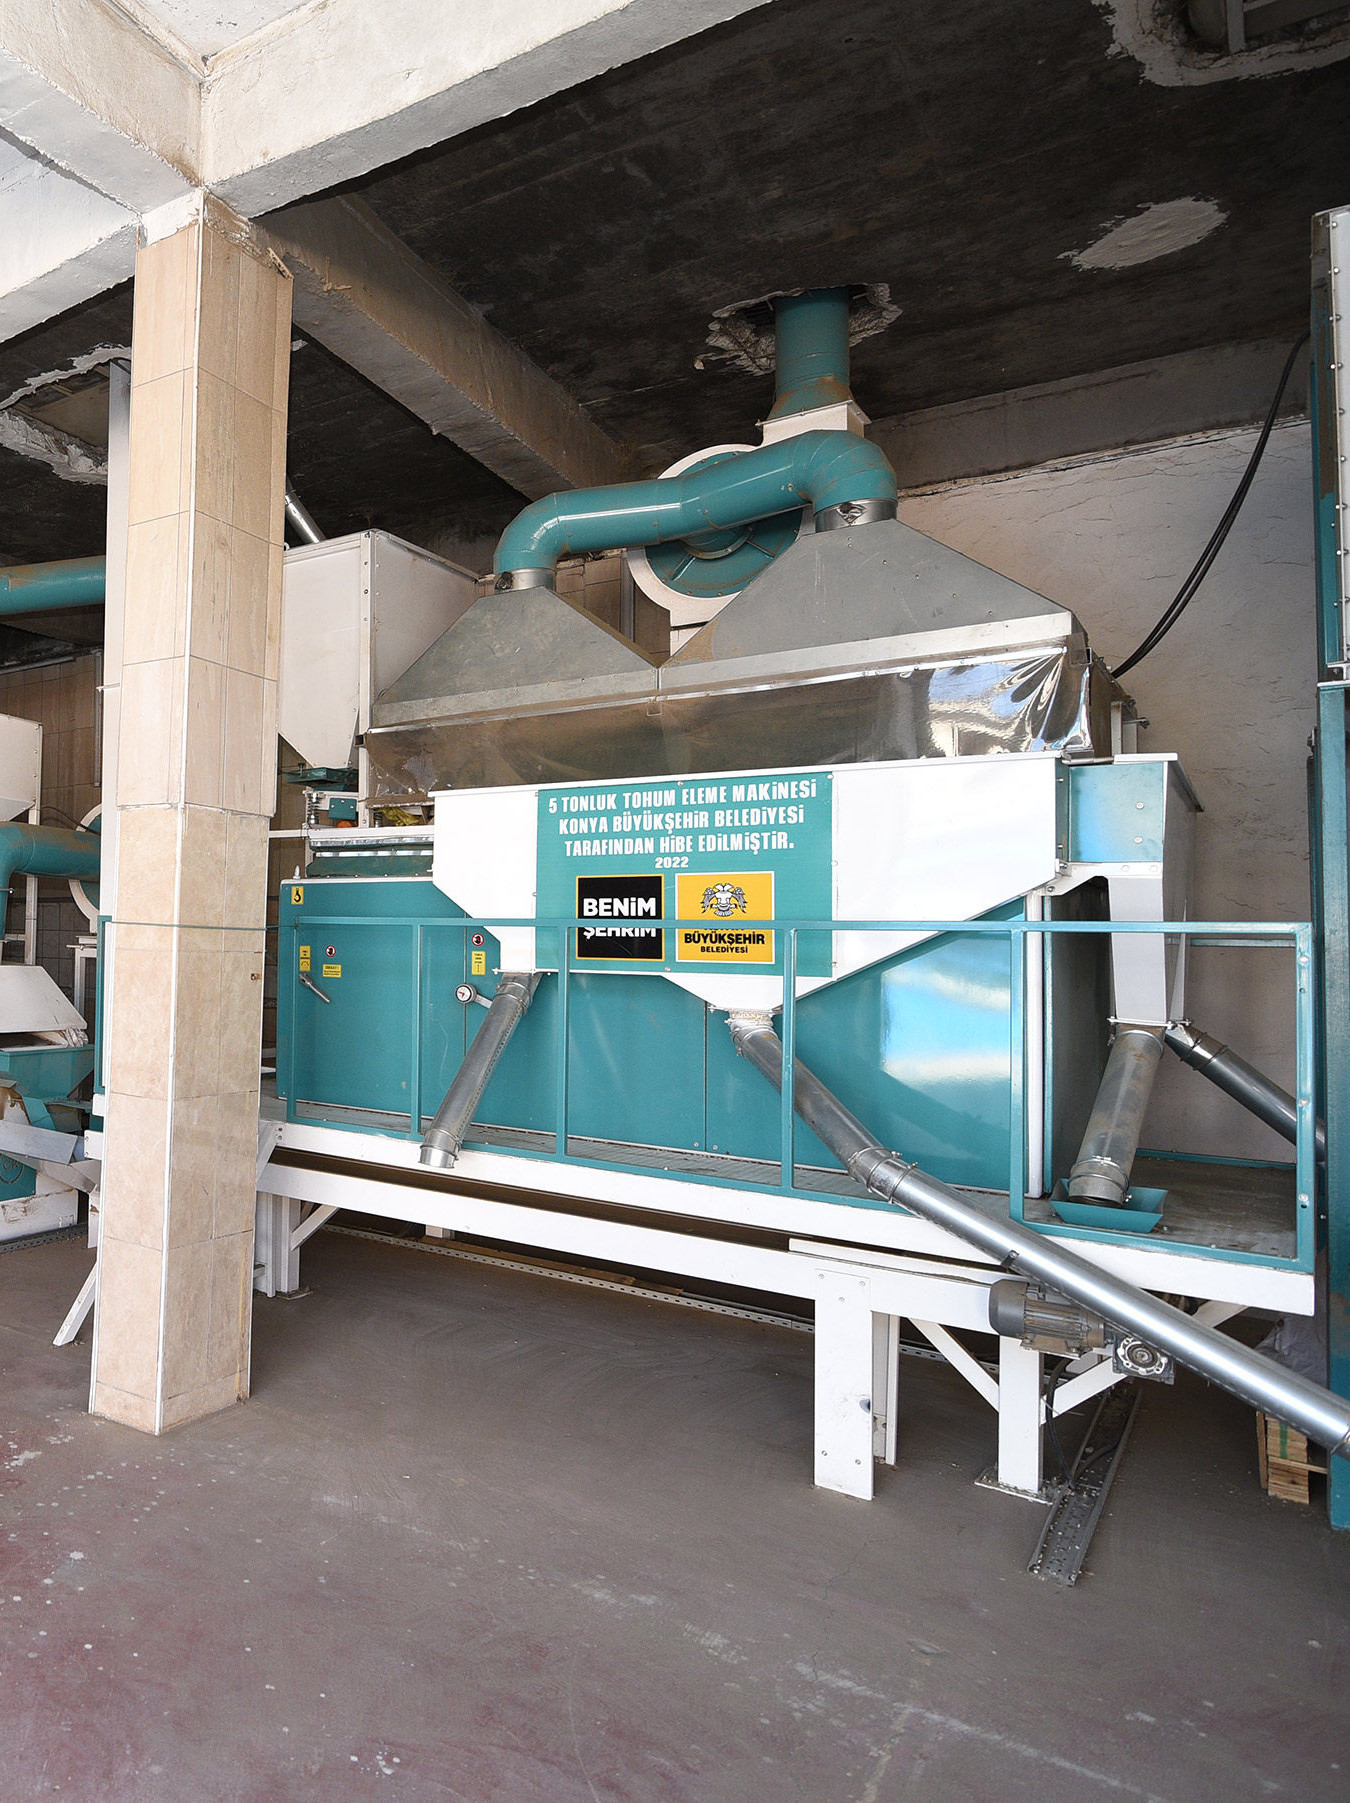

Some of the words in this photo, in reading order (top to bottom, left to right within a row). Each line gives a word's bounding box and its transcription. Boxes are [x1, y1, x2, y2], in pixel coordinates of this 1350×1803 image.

[548, 797, 558, 814] 5
[561, 793, 618, 813] TONLUK
[622, 789, 676, 810] TOHUM
[681, 785, 727, 806] ELEME
[558, 816, 608, 835] KONYA
[564, 837, 655, 857] TARAFINDAN
[655, 856, 690, 869] 2022
